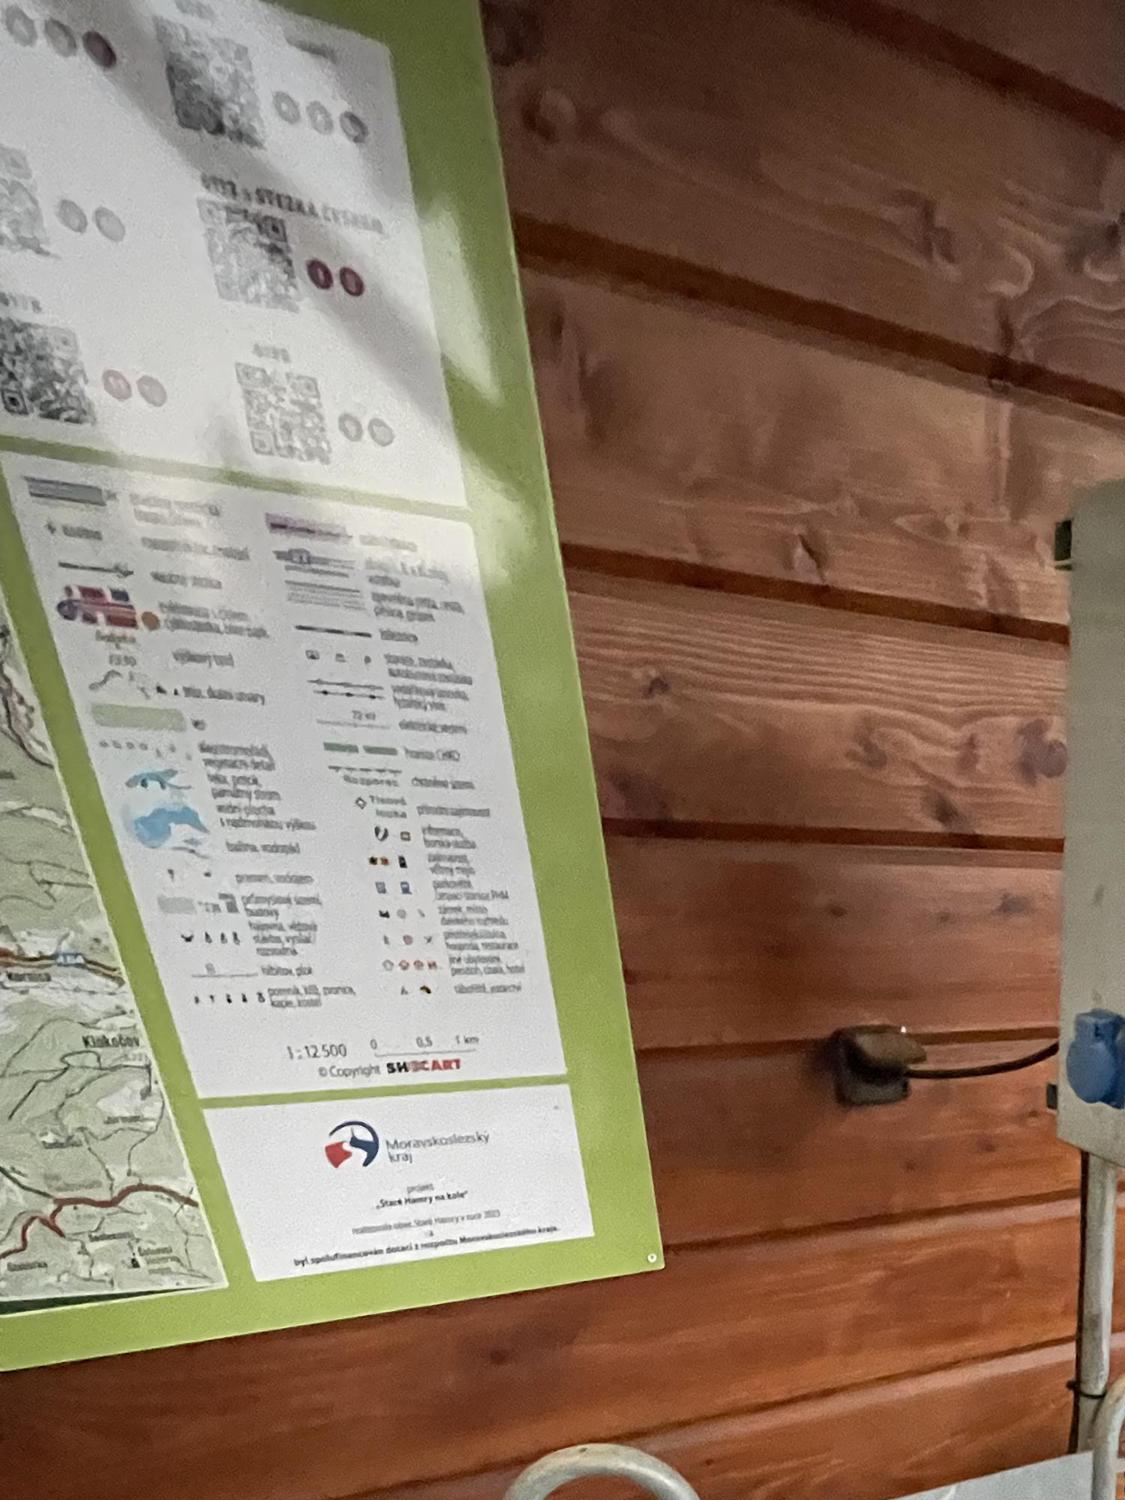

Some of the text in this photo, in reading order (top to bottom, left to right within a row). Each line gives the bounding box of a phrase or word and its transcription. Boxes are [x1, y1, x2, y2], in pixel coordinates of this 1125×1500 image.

[370, 1039, 377, 1049] 0
[329, 1064, 380, 1078] Copyright
[385, 1130, 490, 1150] Moravskoslezský
[389, 1151, 413, 1164] kraj
